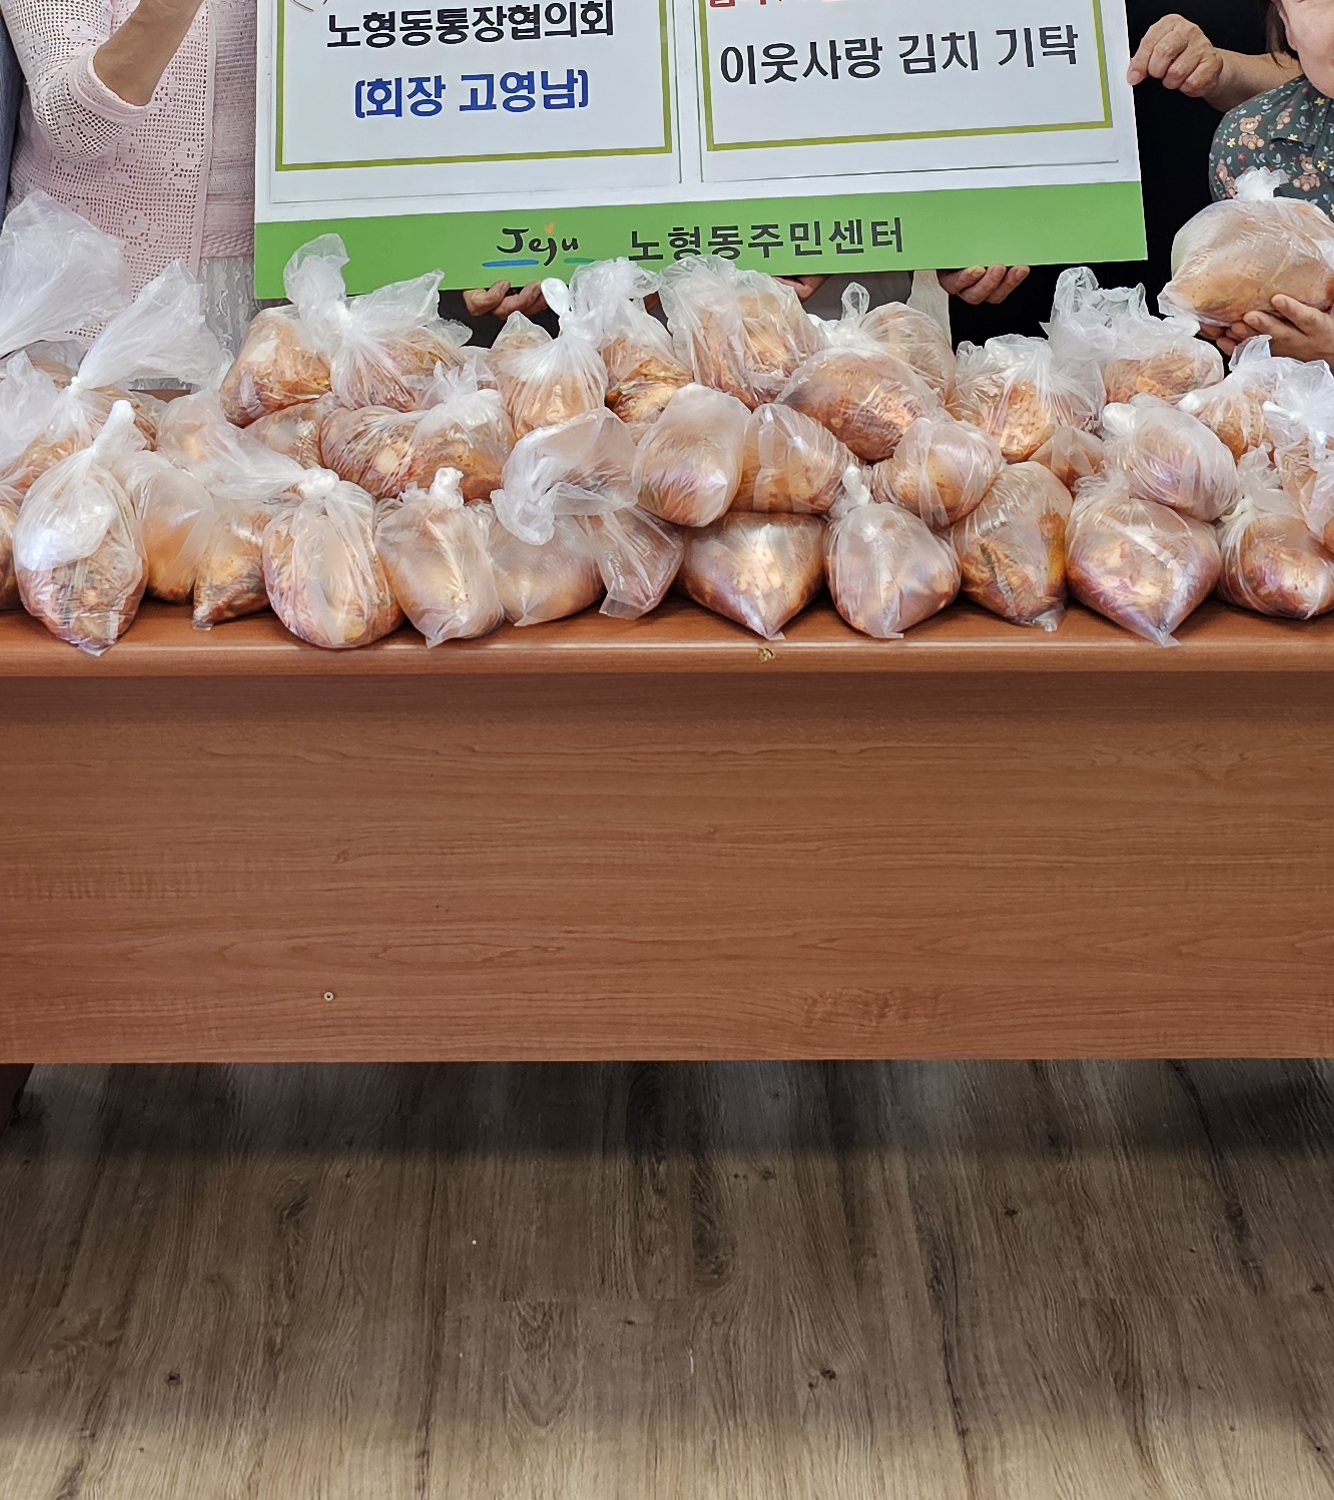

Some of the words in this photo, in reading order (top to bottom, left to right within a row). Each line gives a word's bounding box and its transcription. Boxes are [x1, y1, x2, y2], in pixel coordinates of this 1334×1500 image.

[327, 0, 614, 48] 노형동통장협의회
[720, 36, 883, 84] 이웃사랑
[898, 29, 979, 75] 김치
[996, 24, 1079, 68] 기탁
[496, 226, 580, 266] Jeju
[628, 216, 904, 262] 노형동주민센터
